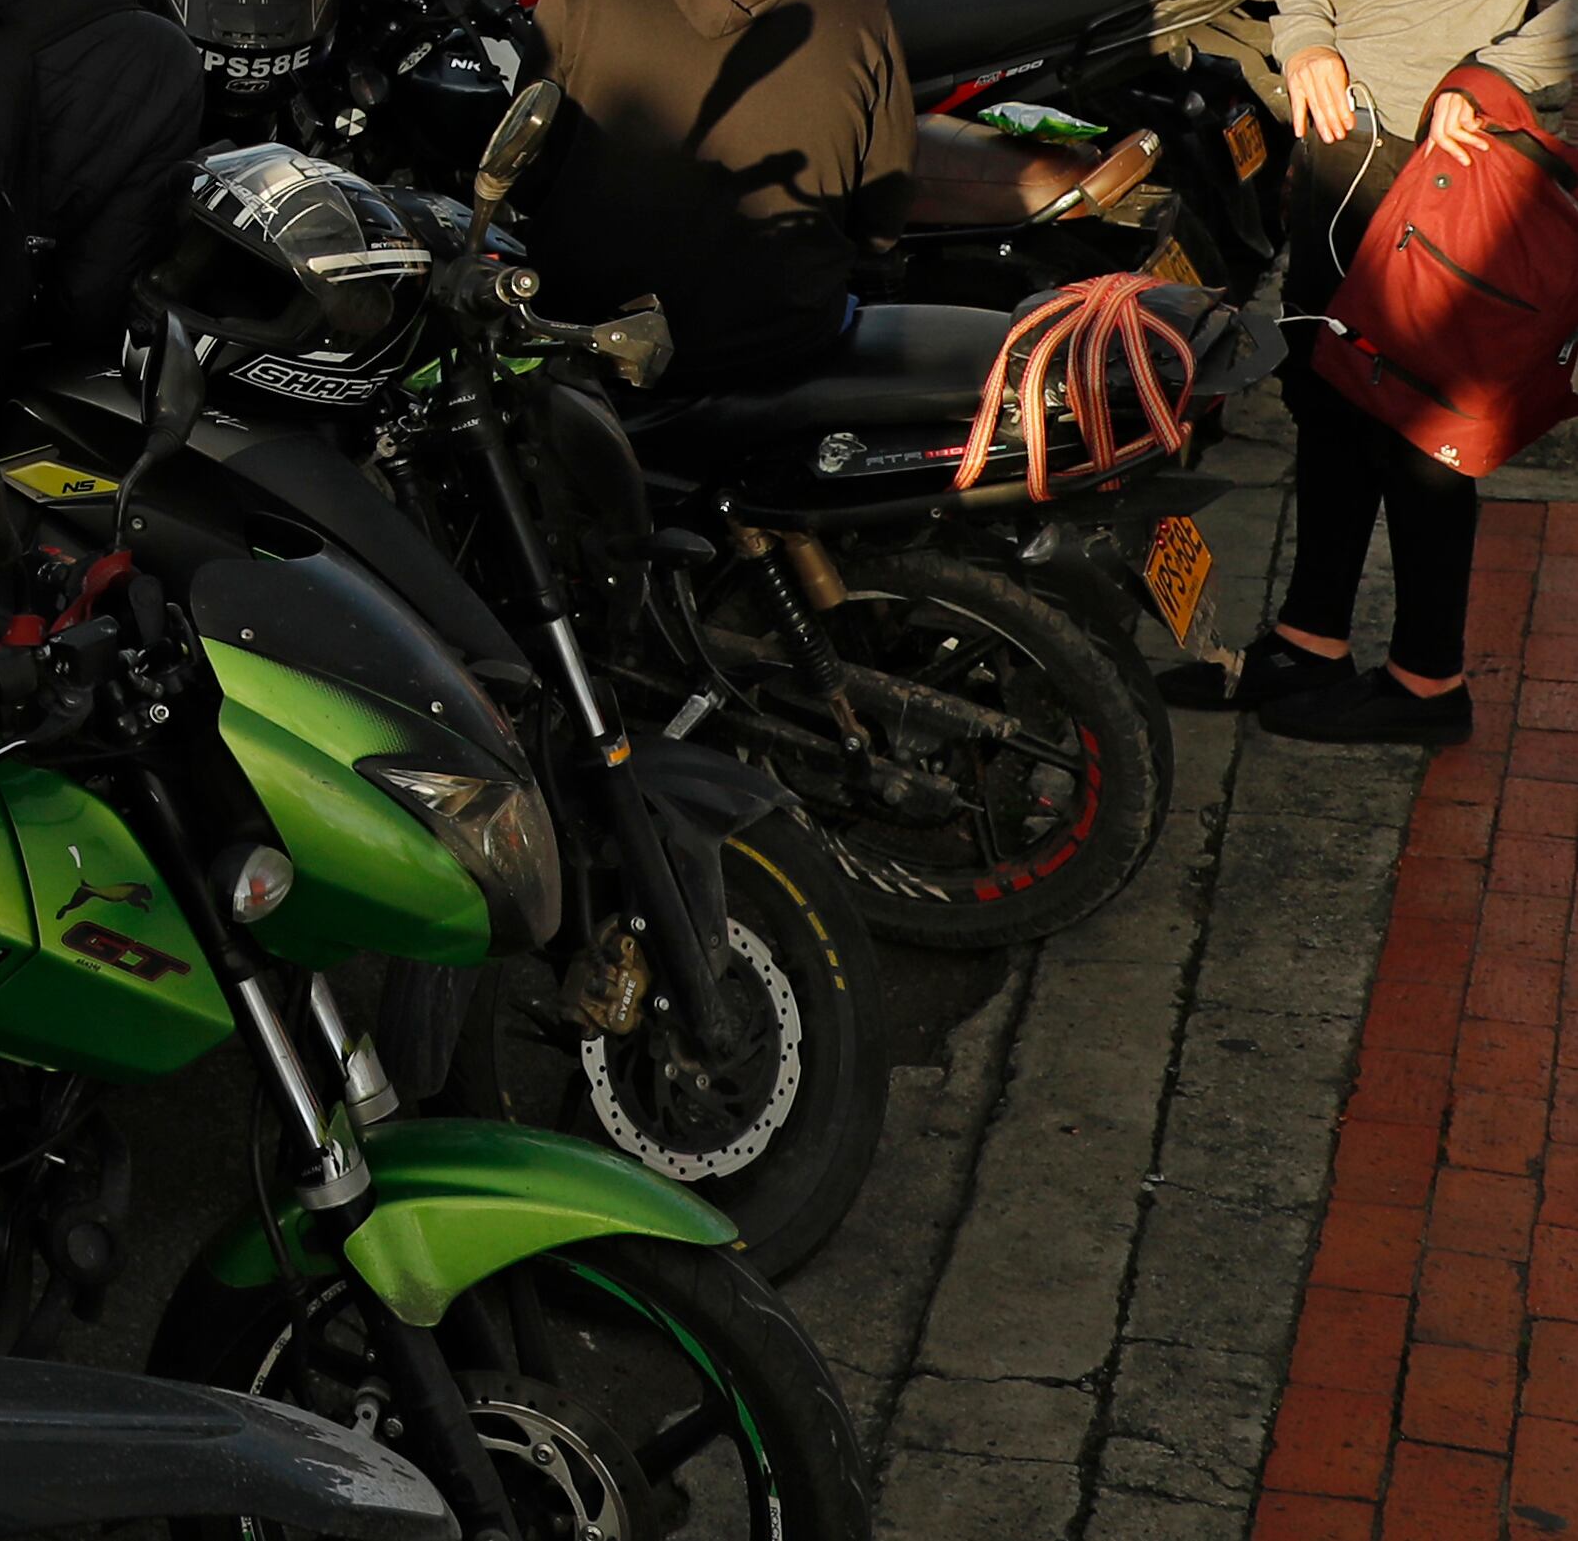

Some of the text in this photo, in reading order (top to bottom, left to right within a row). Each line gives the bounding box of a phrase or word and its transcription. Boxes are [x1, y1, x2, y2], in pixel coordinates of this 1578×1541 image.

[451, 58, 481, 72] NK
[250, 362, 386, 399] SHAFT
[61, 479, 97, 495] NS
[61, 920, 192, 983] GT
